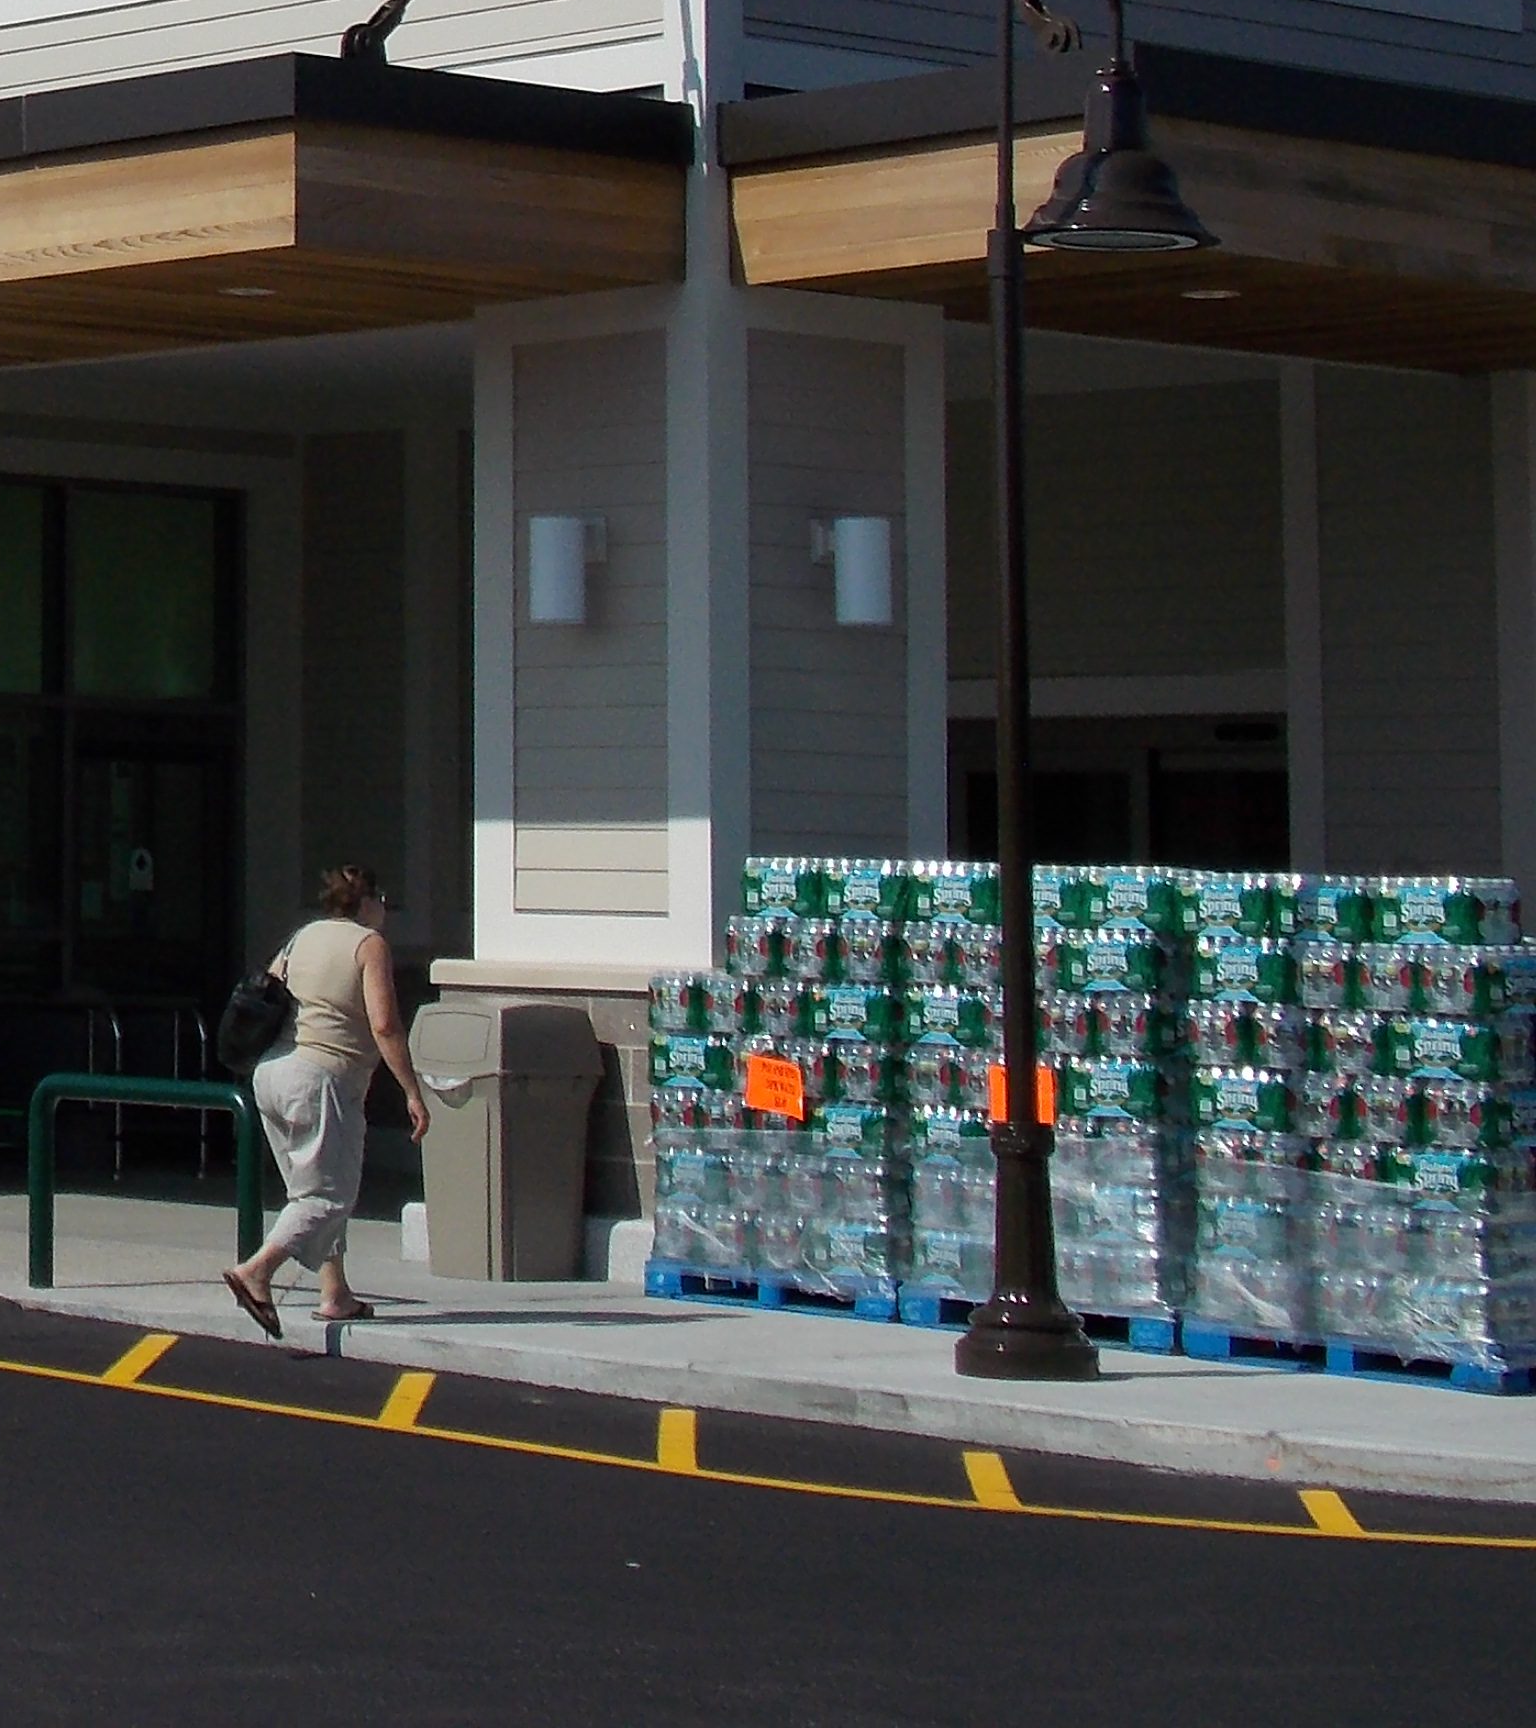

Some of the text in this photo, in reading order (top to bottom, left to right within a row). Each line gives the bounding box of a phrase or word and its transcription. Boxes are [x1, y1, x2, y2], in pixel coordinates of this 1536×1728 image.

[1107, 891, 1148, 910] Spring
[1199, 899, 1243, 919] Spring
[1400, 903, 1446, 924] Spring
[1086, 954, 1128, 973] Spring
[1216, 963, 1258, 982] Spring
[1414, 1038, 1462, 1060] Spring
[1089, 1078, 1130, 1098] Spring
[1409, 1171, 1459, 1193] Spring
